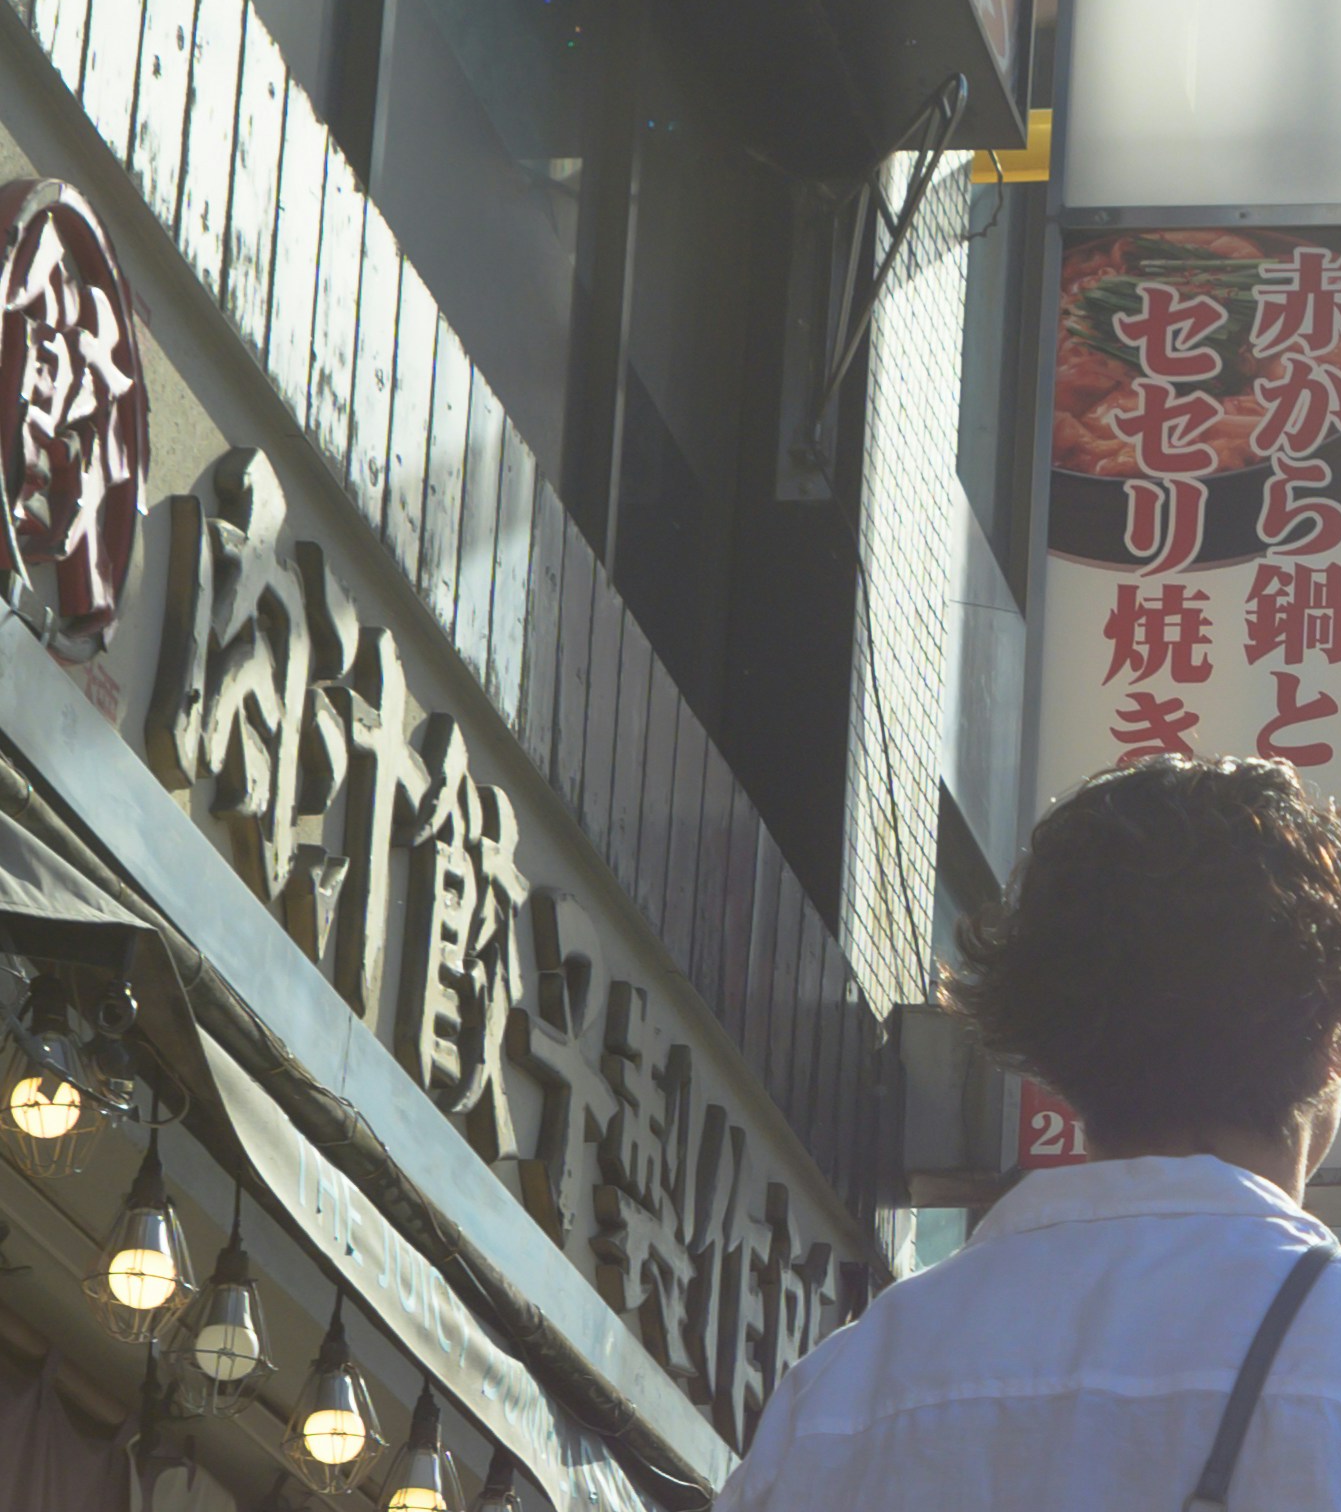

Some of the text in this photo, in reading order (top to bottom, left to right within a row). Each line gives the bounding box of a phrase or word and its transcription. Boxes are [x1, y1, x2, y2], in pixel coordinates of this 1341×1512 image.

[1104, 283, 1226, 762] セセリ焼き
[295, 1131, 364, 1267] THE
